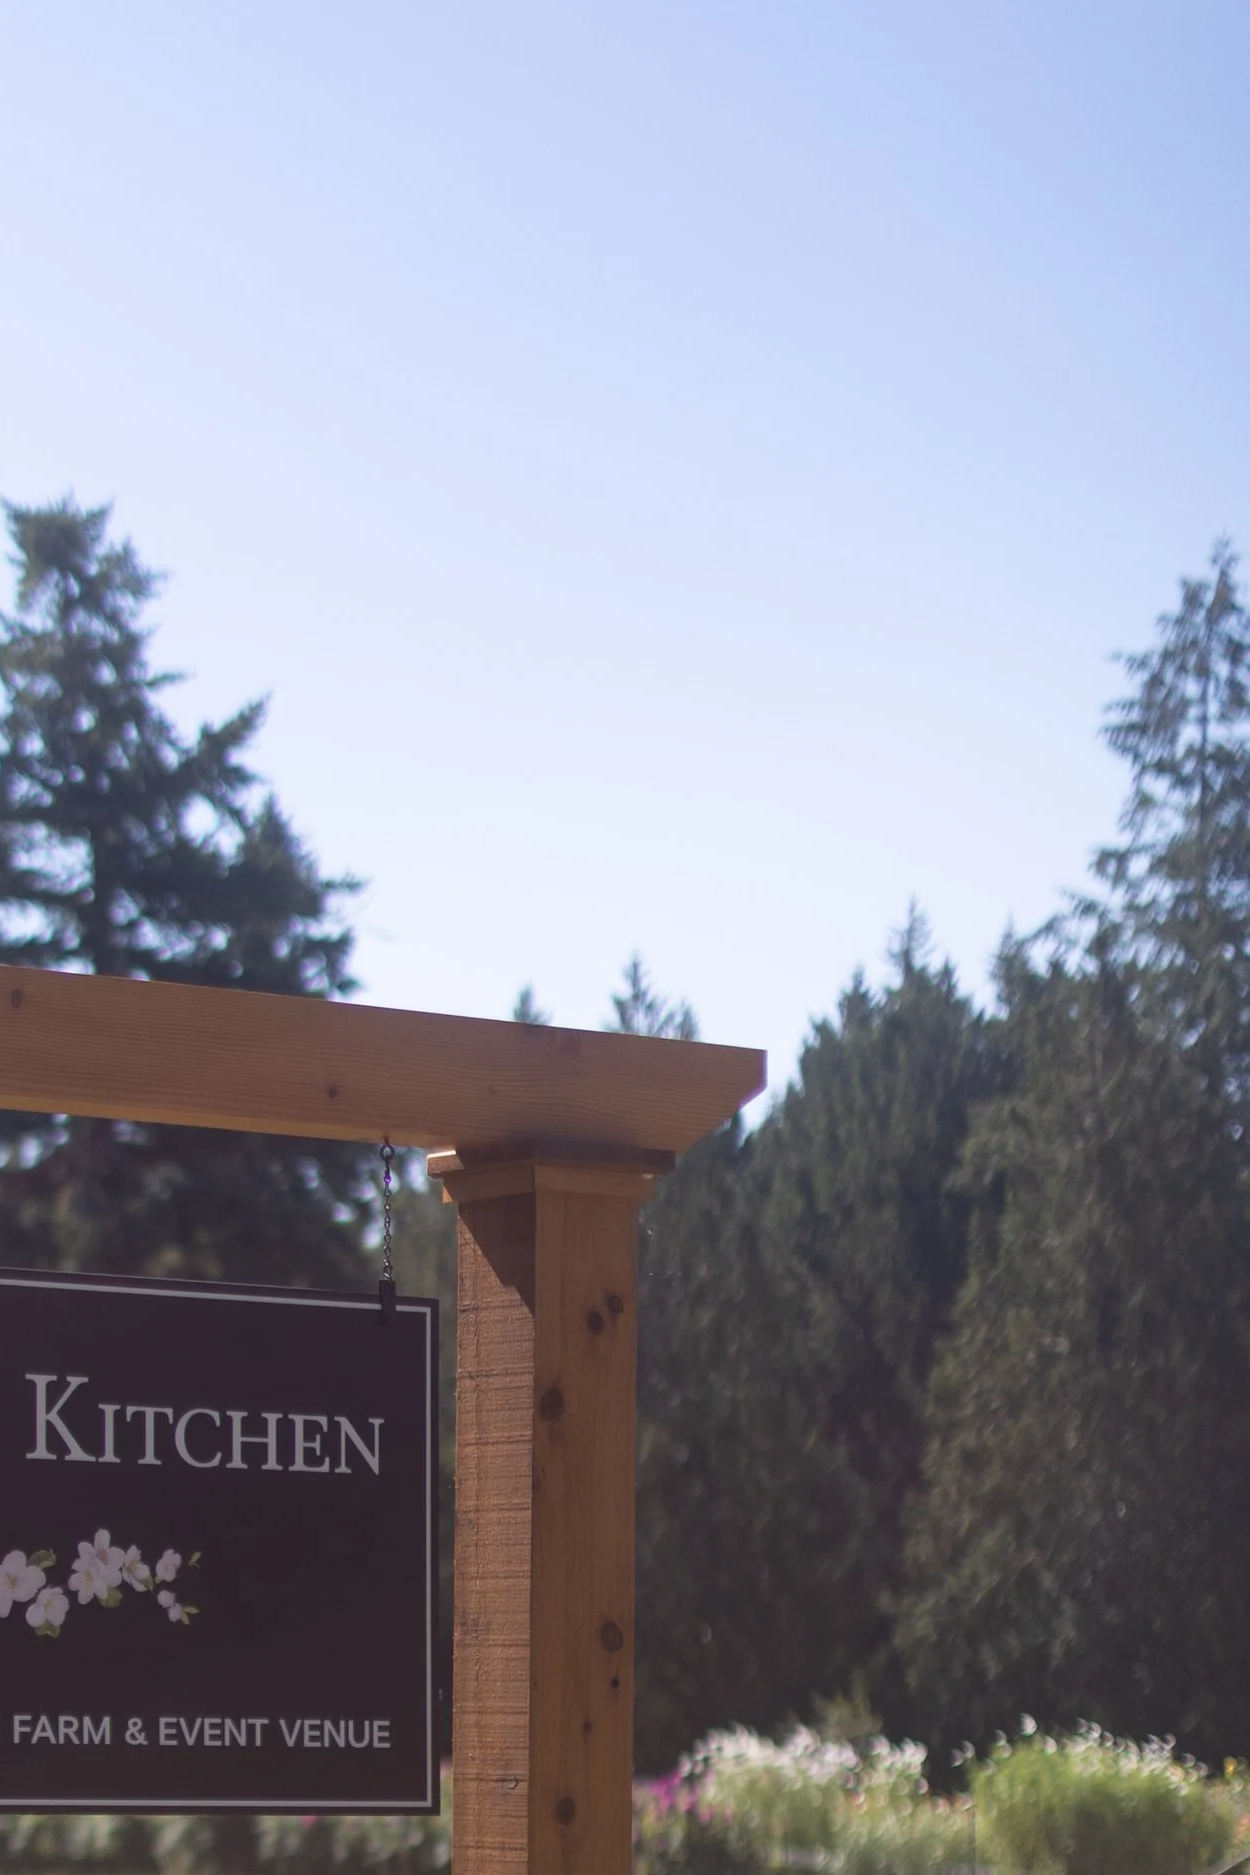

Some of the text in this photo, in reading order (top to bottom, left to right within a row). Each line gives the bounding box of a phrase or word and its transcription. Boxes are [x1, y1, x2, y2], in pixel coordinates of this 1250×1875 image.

[26, 1374, 384, 1475] KITCHEN
[14, 1715, 110, 1744] FARM
[125, 1718, 148, 1745] &
[159, 1717, 269, 1746] EVENT
[279, 1719, 390, 1748] VENUE
